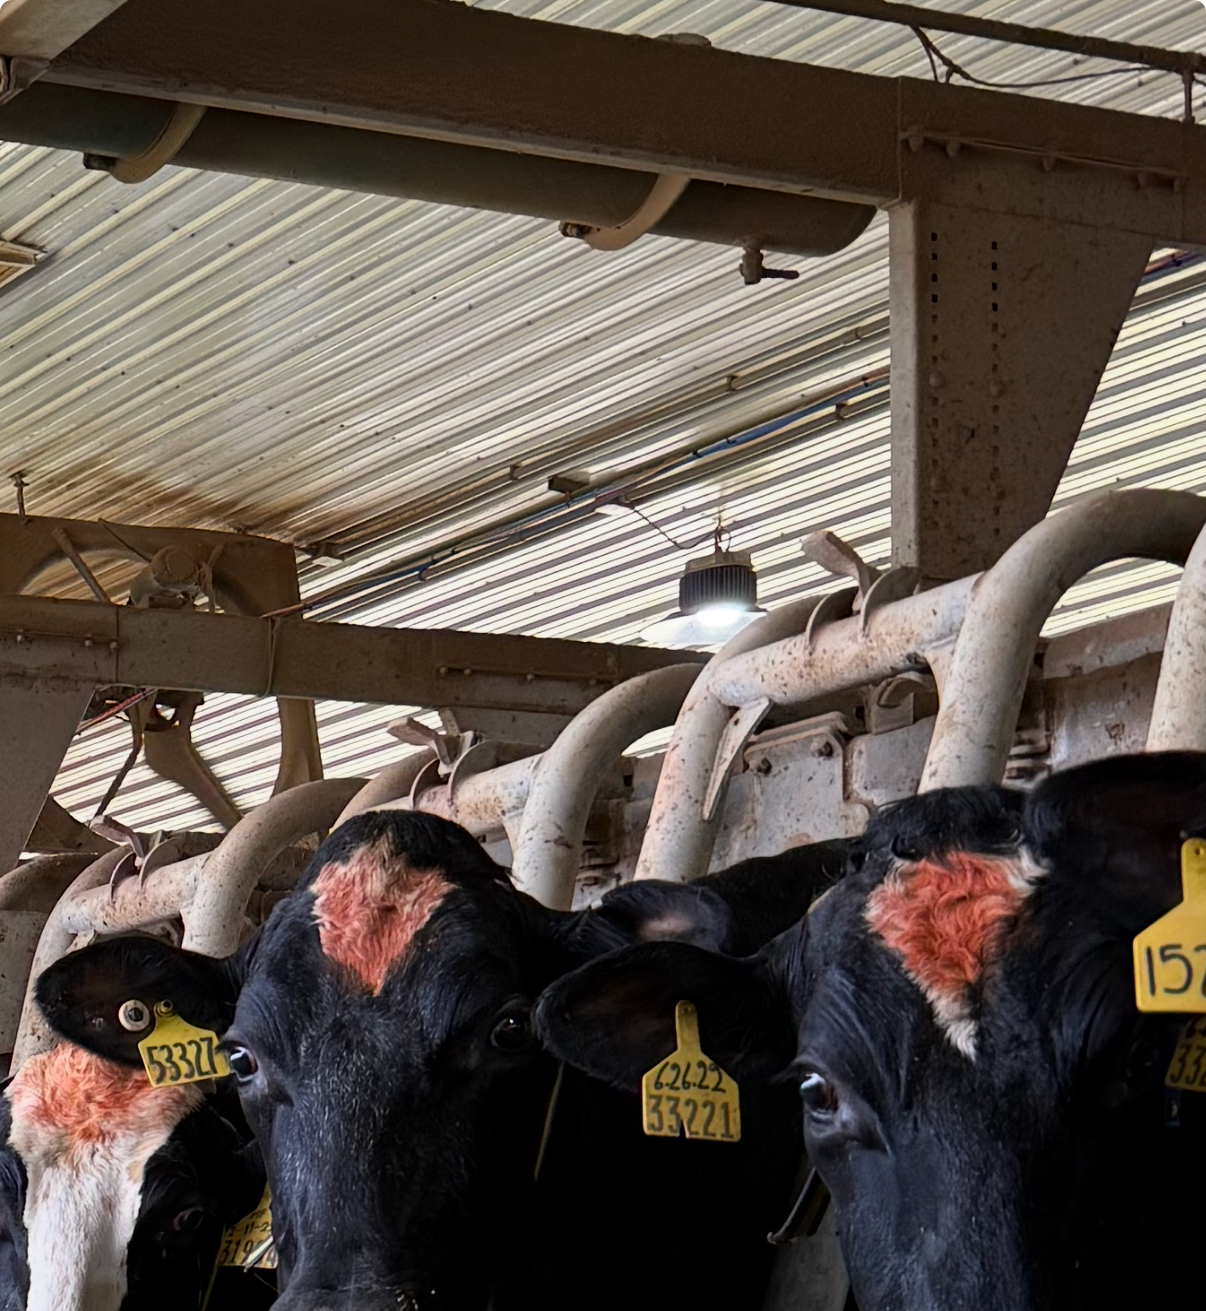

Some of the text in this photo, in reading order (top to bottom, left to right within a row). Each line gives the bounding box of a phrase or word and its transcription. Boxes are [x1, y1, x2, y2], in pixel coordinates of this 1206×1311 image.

[146, 1036, 218, 1085] 53327
[654, 1060, 727, 1094] 6.26.22
[648, 1094, 735, 1139] 33221
